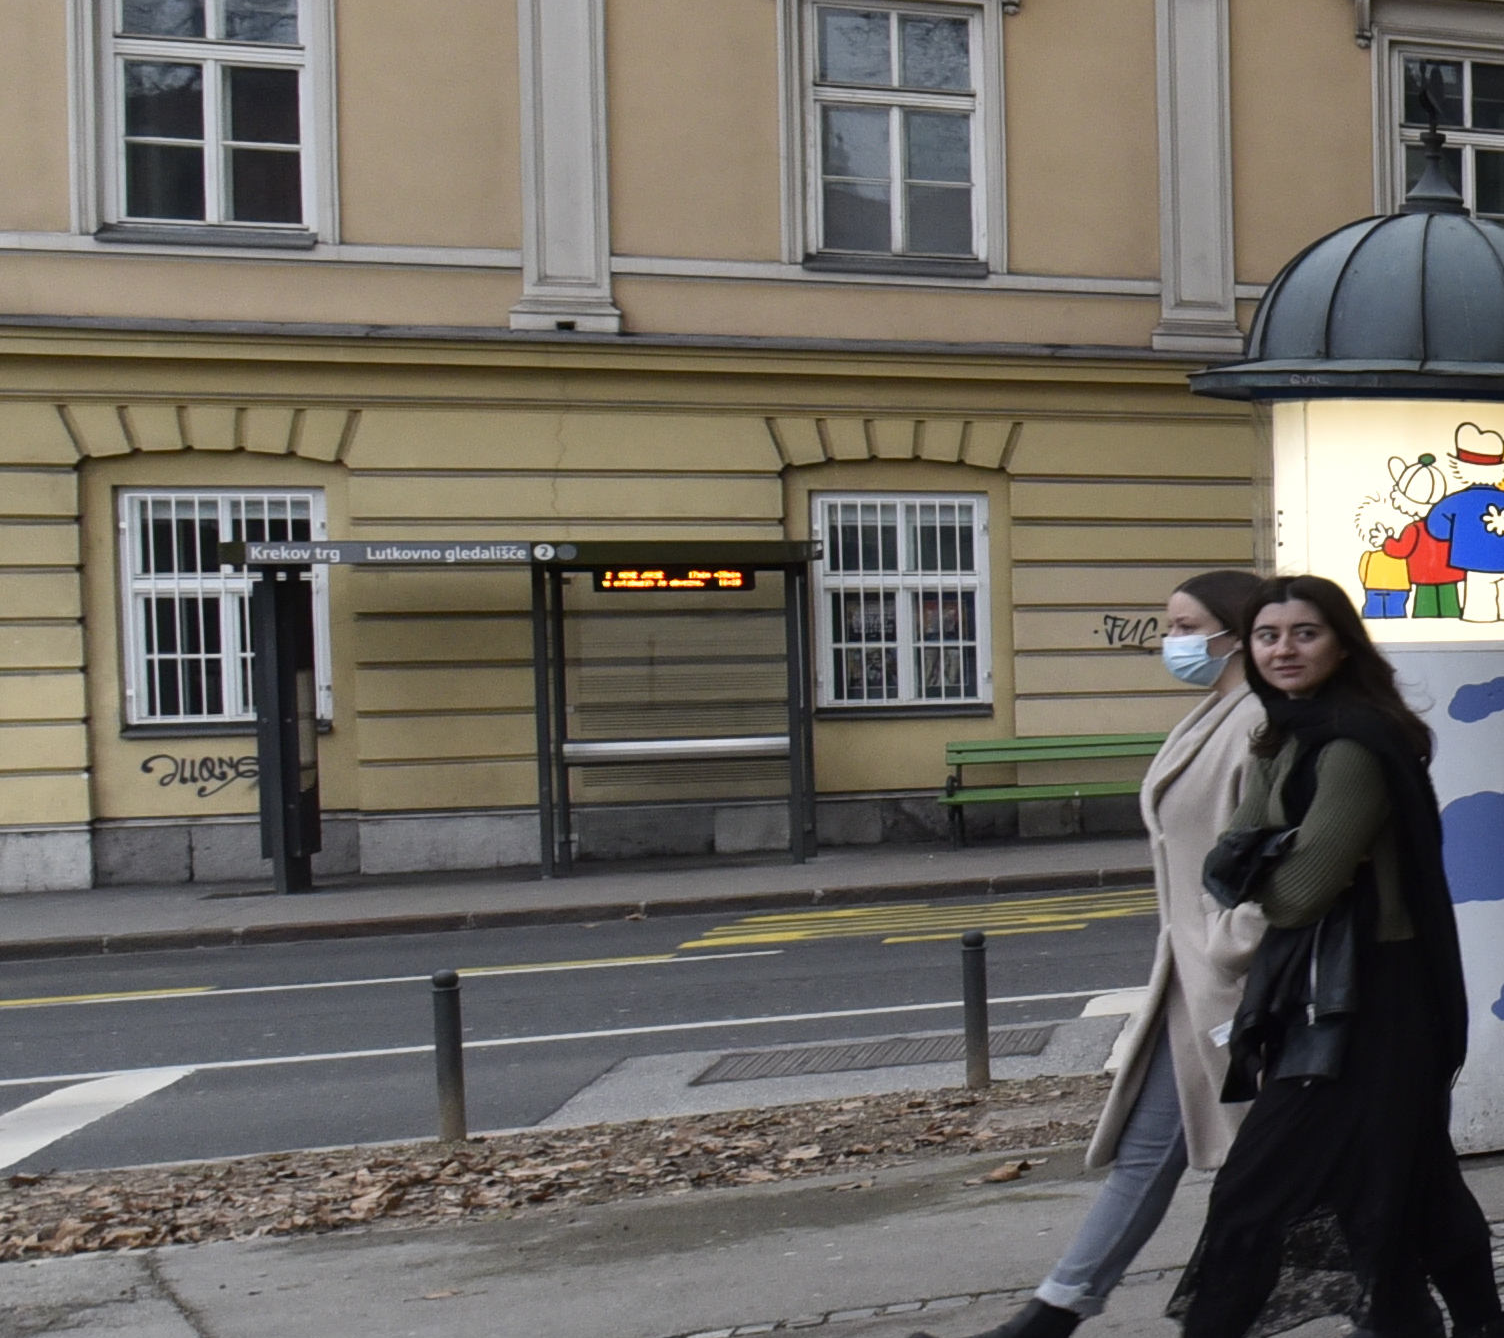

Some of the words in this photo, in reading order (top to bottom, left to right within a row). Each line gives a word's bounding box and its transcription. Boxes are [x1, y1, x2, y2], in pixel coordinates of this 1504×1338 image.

[250, 546, 311, 560] Krekov
[315, 547, 340, 562] trg
[366, 546, 441, 560] Lutkovno
[445, 545, 526, 562] gledališče
